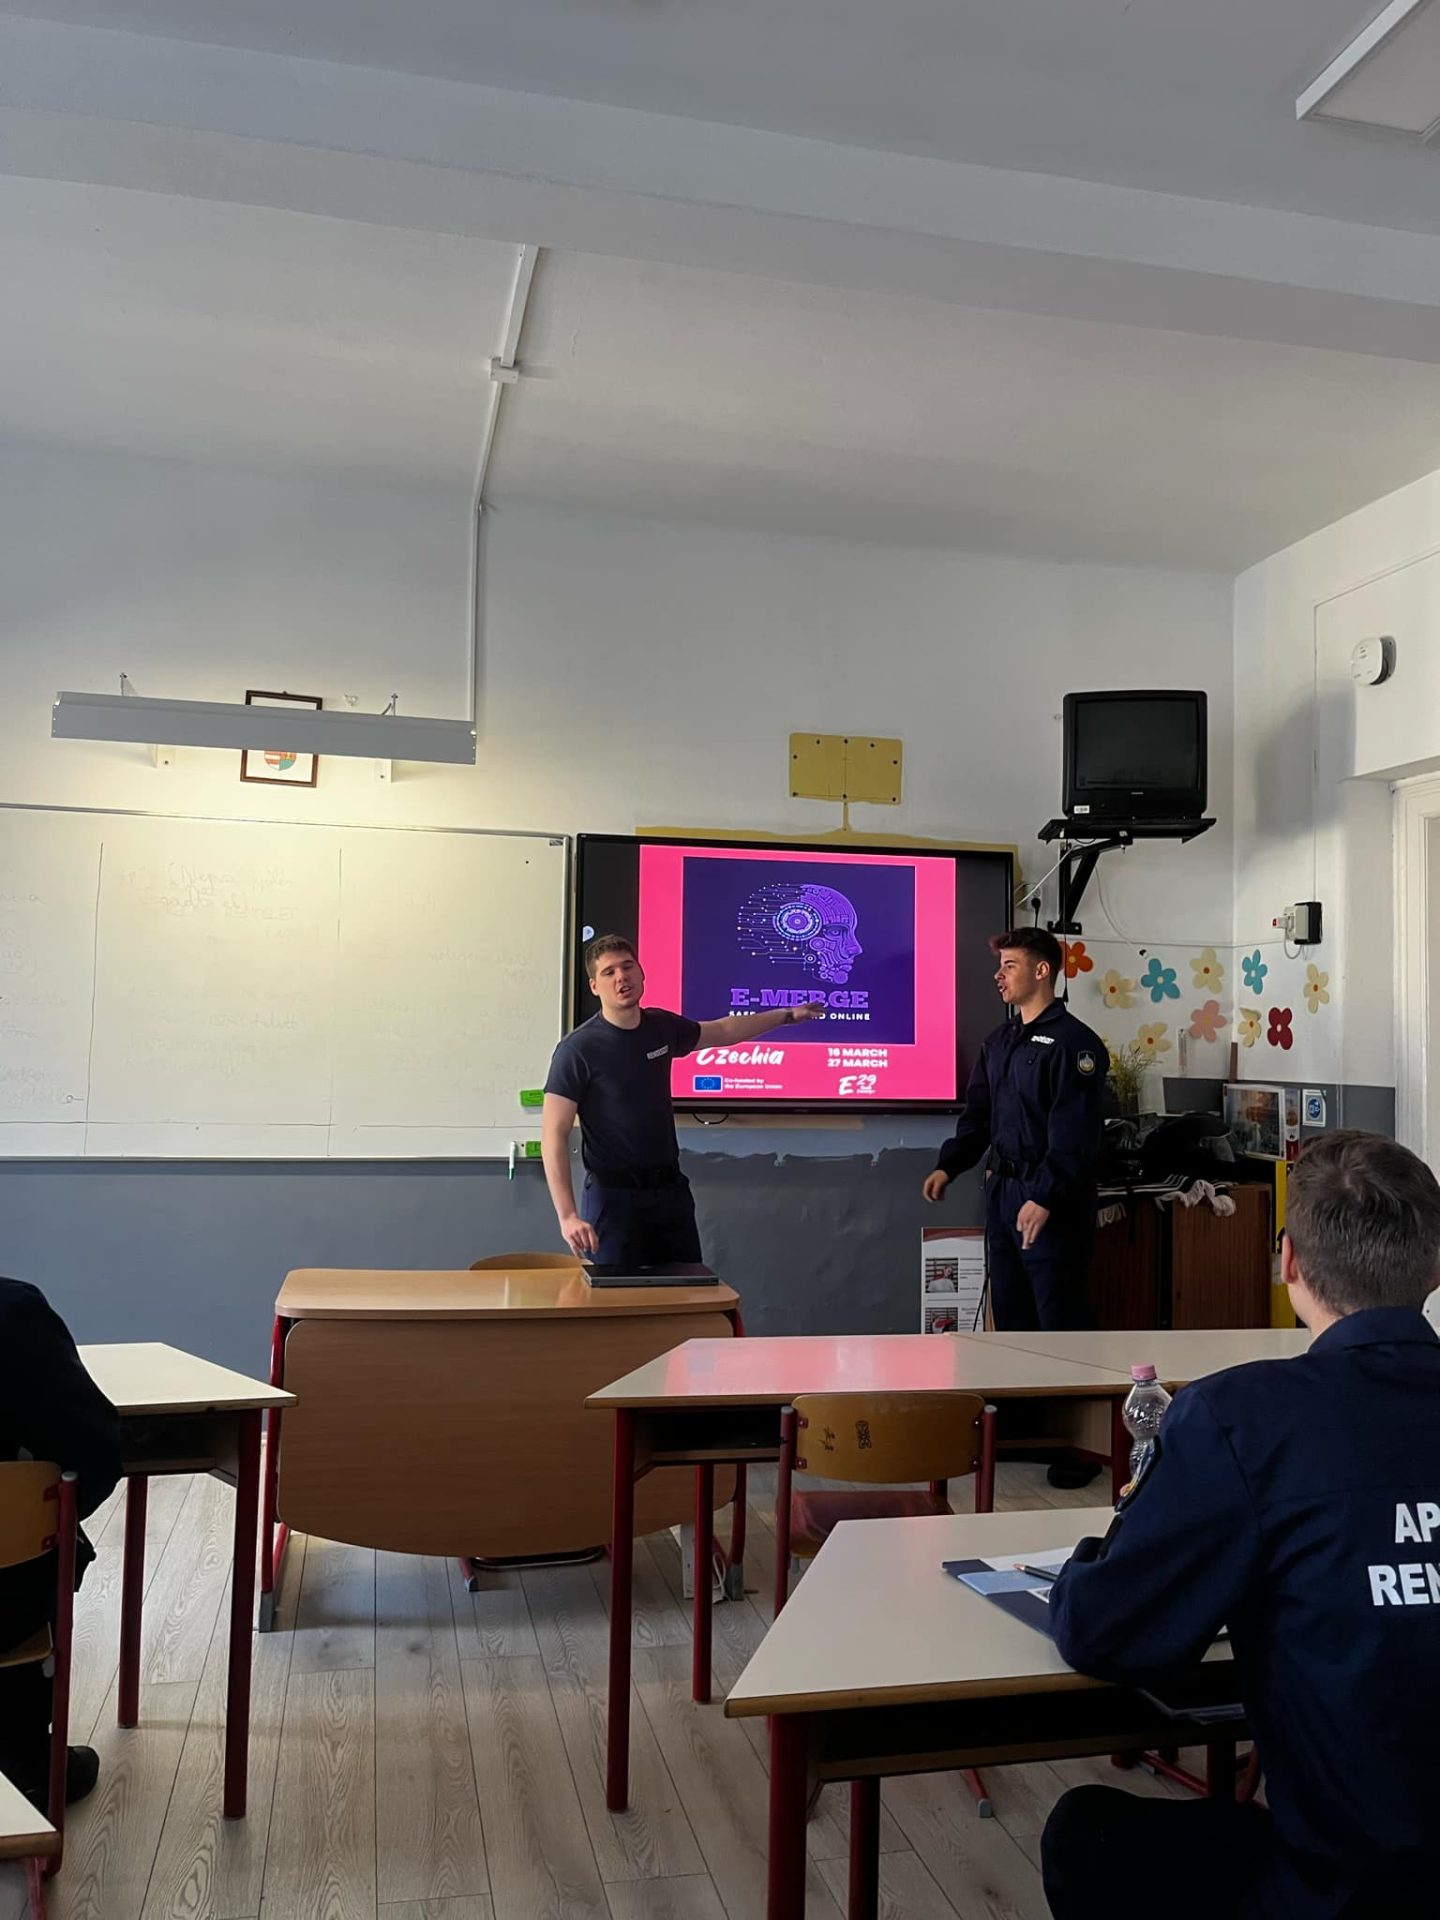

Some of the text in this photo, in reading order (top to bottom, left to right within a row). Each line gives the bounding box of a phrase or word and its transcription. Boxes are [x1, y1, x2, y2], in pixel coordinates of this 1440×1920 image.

[730, 988, 869, 1008] E-MERGE
[829, 1012, 870, 1020] ONLINE
[696, 1045, 785, 1065] Czechia
[842, 1048, 888, 1057] MARCH
[827, 1058, 888, 1068] 27 MARCH
[1394, 1502, 1440, 1543] AP
